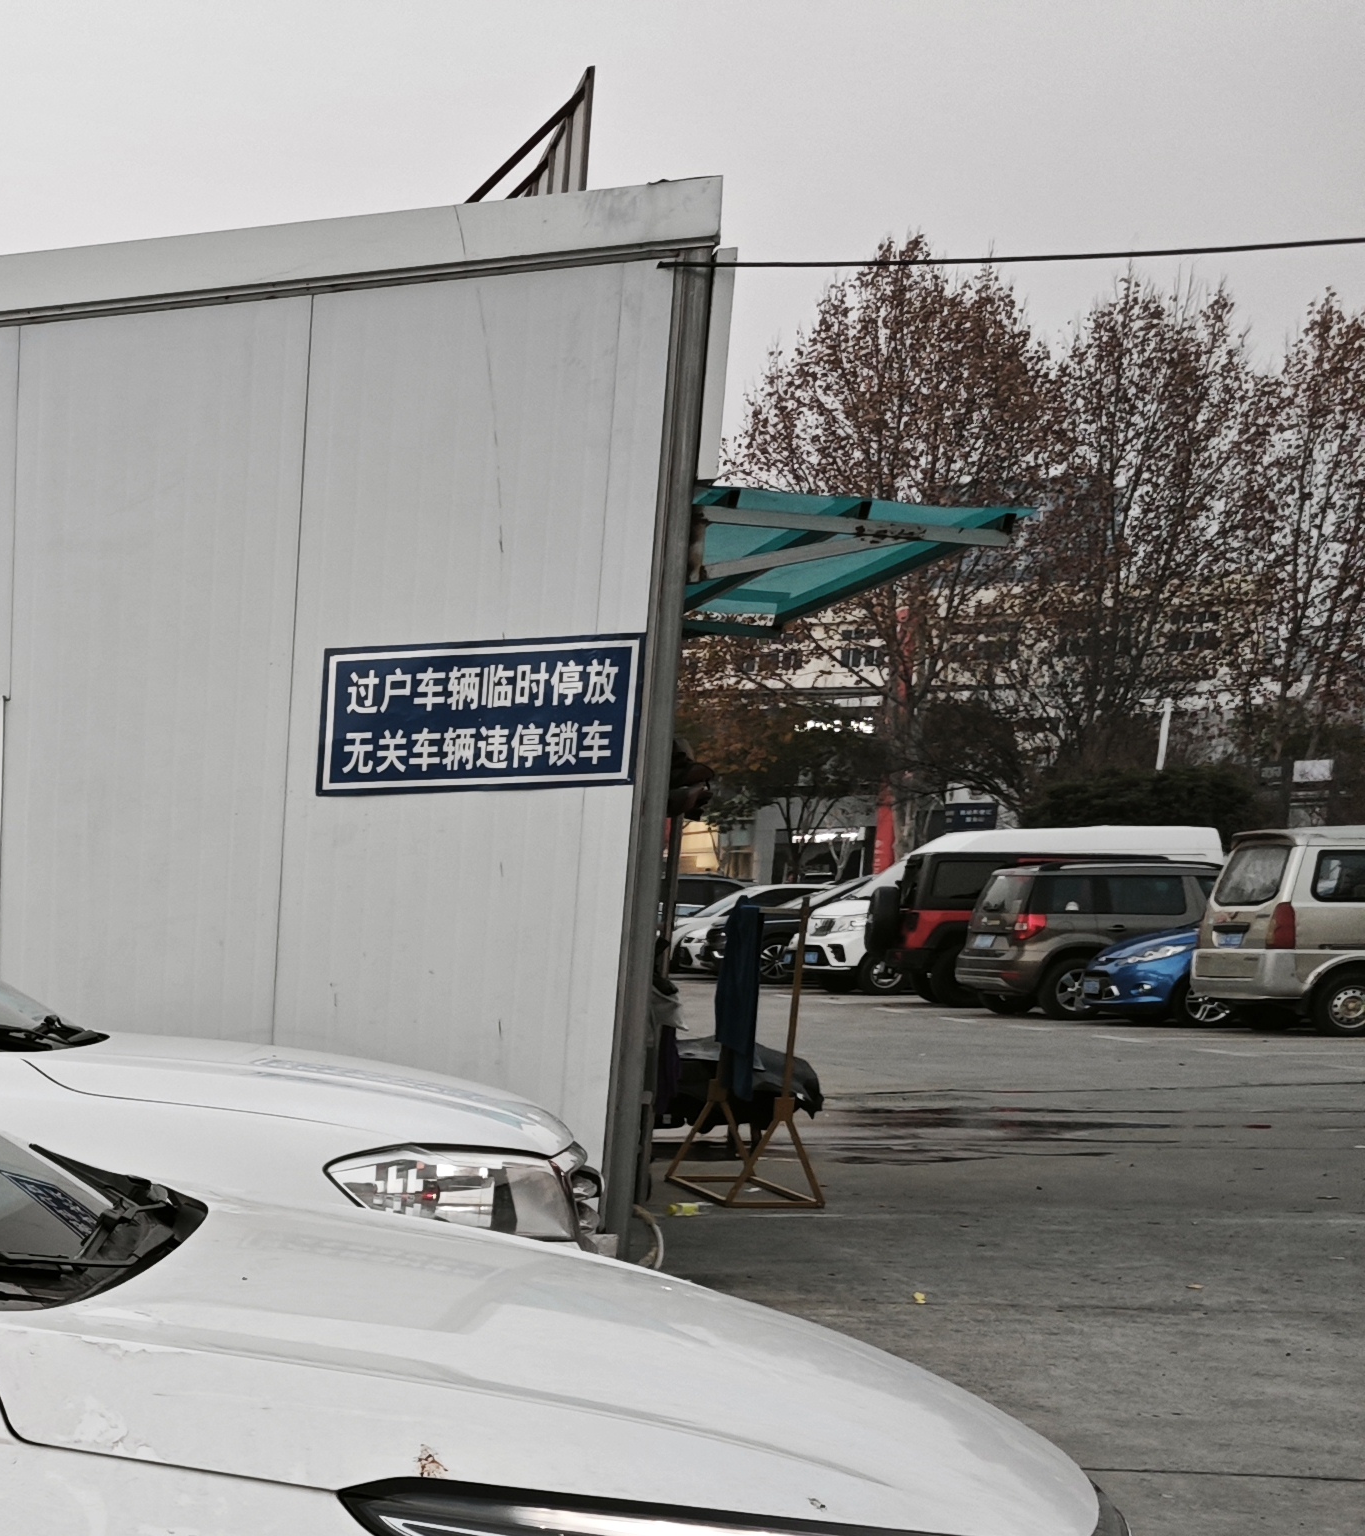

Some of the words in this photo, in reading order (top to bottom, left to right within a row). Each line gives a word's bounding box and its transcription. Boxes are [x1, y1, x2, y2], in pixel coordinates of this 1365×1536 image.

[346, 658, 619, 714] 过户车辆临时停放
[342, 720, 613, 774] 无关车辆违停锁车
